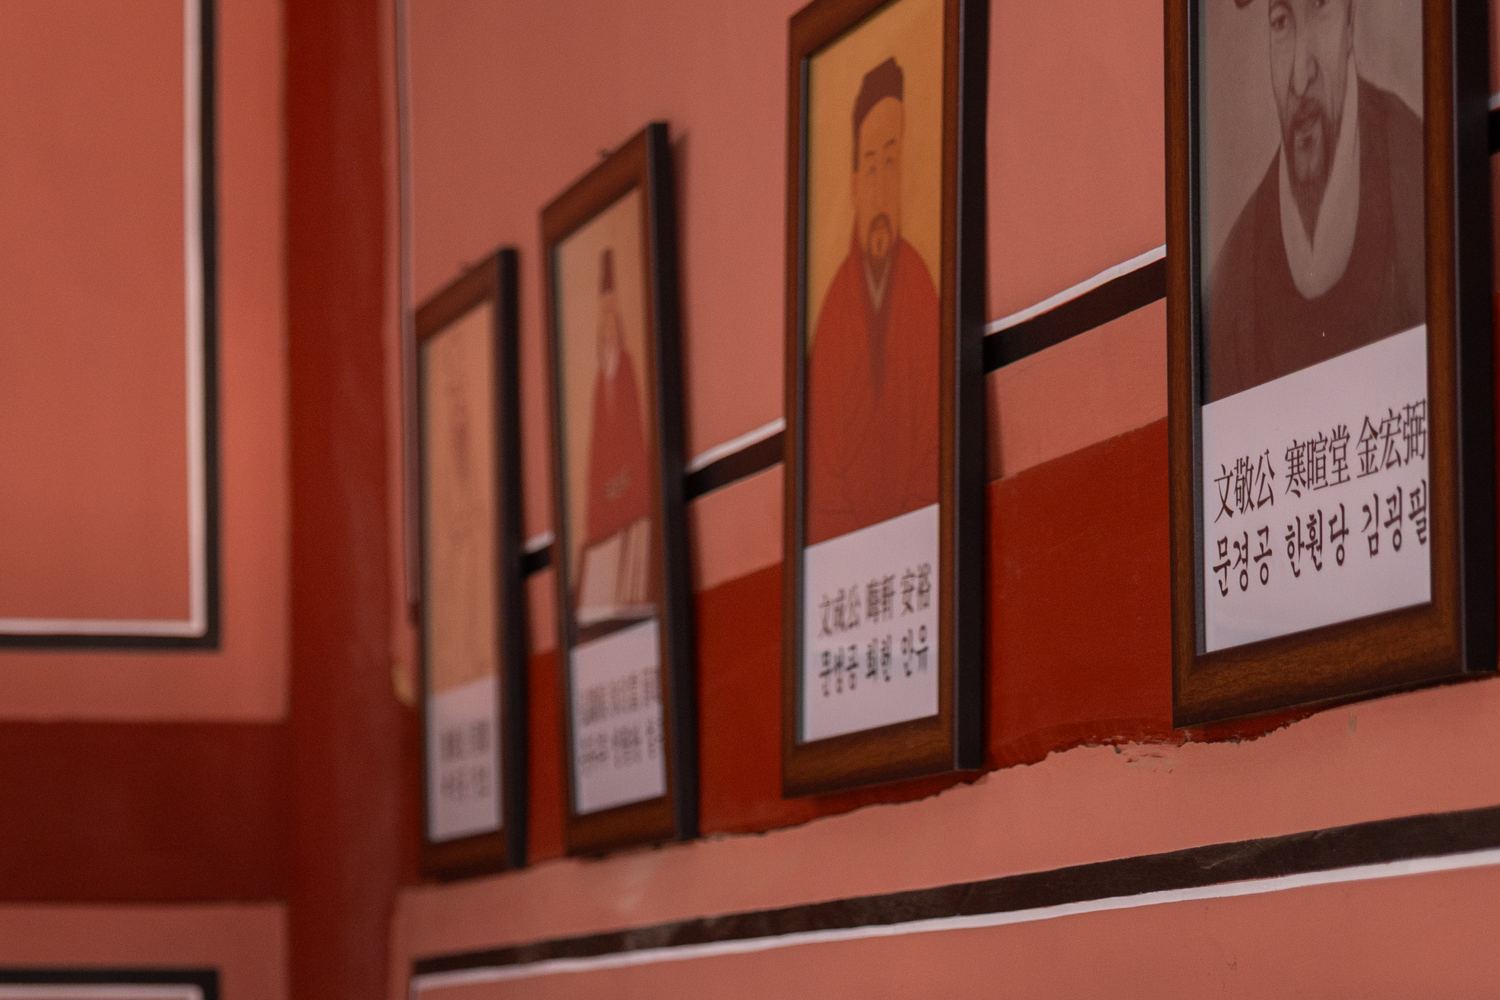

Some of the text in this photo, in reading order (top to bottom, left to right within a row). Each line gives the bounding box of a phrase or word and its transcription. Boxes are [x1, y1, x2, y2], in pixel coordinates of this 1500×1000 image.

[1214, 398, 1427, 523] 文敬公 寒暄堂 金宏弼
[1213, 479, 1428, 598] 문경공 한훤당 김굉필
